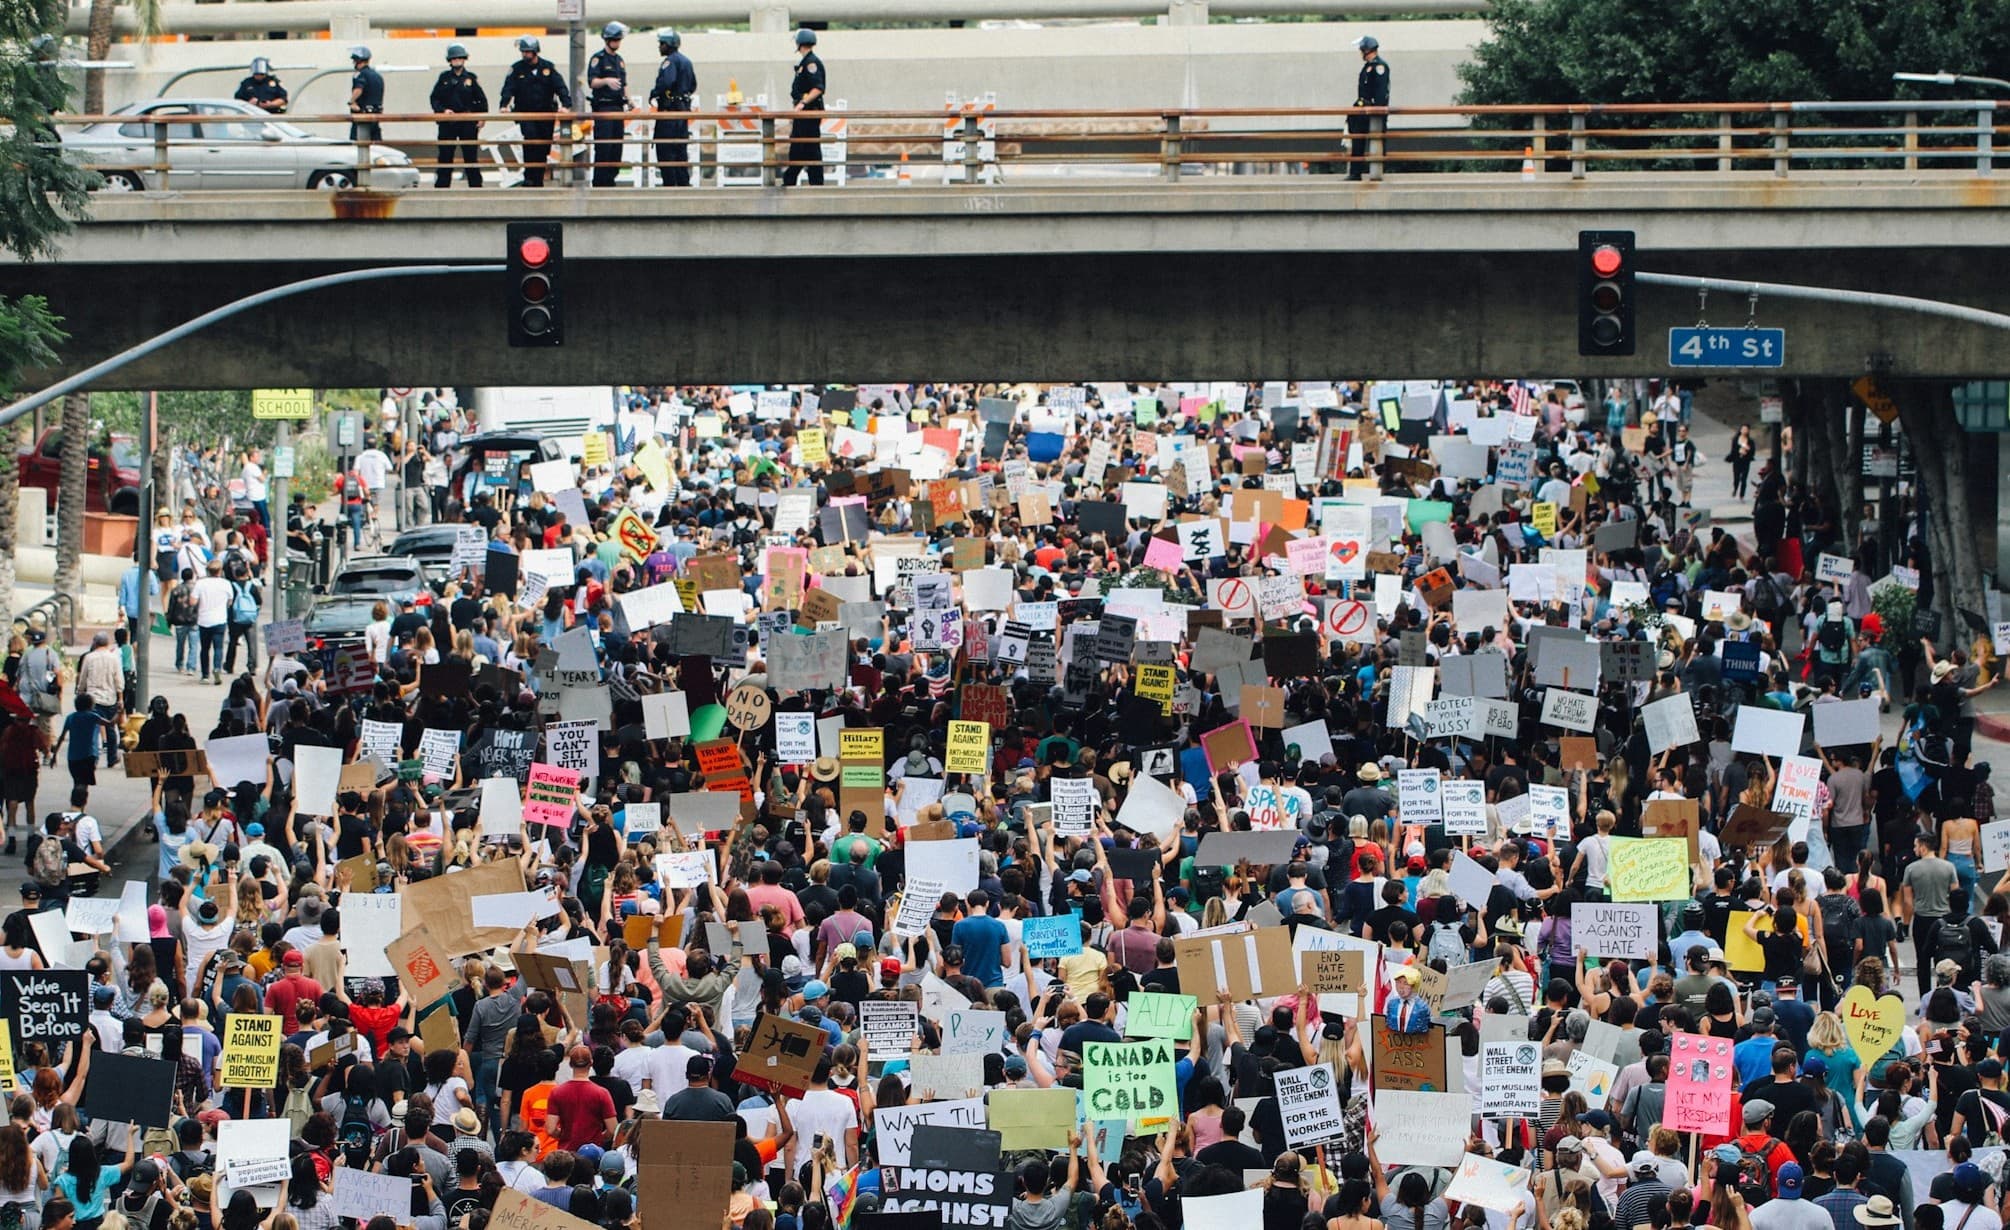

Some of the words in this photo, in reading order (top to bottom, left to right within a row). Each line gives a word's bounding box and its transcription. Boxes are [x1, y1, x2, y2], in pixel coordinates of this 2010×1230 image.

[1679, 335, 1730, 359] 4th
[1742, 338, 1773, 358] St
[258, 402, 309, 414] SCHOOL
[898, 557, 940, 575] OBSTRUCT
[1724, 658, 1756, 671] THINK
[545, 670, 555, 683] 4
[562, 670, 596, 684] YEARS
[1143, 667, 1169, 682] STAND
[1141, 679, 1170, 692] AGAINST
[736, 689, 764, 707] NO
[964, 686, 1003, 701] CIVIL
[1427, 697, 1473, 712] PROTECT
[1557, 696, 1570, 706] NO
[1569, 698, 1587, 710] HATE
[727, 704, 761, 729] DAPL
[1438, 709, 1462, 720] YOUR
[1552, 704, 1567, 715] NO
[1568, 707, 1588, 719] TRUMP
[546, 721, 569, 731] DEAR
[571, 719, 598, 729] TRUMP
[779, 726, 797, 734] FIGHT
[954, 724, 982, 735] STAND
[1430, 719, 1471, 734] PUSSY
[1497, 718, 1513, 731] BAD
[559, 730, 584, 740] YOU
[843, 734, 881, 744] Hillary
[952, 733, 983, 746] AGAINST
[553, 739, 591, 751] CAN'T
[701, 746, 731, 758] TRUMP
[480, 747, 511, 765] NEVER
[511, 748, 534, 762] MADE
[562, 750, 584, 761] SIT
[780, 749, 814, 757] WORKERS
[948, 748, 985, 760] ANTI-MUSLIM
[556, 759, 588, 769] WITH
[950, 757, 982, 768] BIGOTRY!
[1785, 761, 1818, 783] LOVE
[1401, 784, 1422, 793] FIGHT
[1402, 800, 1418, 808] FOR
[1445, 795, 1466, 803] FIGHT
[1531, 798, 1551, 807] FIGHT
[1402, 808, 1440, 817] WORKERS
[1447, 810, 1462, 818] FOR
[1463, 809, 1478, 817] THE
[1776, 800, 1808, 818] HATE
[1447, 817, 1485, 828] WORKERS
[1532, 812, 1548, 821] FOR
[1595, 909, 1642, 923] UNITED
[1030, 928, 1069, 941] SURVIVING
[1585, 924, 1644, 941] AGAINST
[1599, 938, 1638, 955] HATE
[1321, 952, 1342, 964] END
[1317, 963, 1346, 975] HATE
[1319, 974, 1345, 983] DUMP
[13, 975, 60, 997] We've
[1313, 983, 1349, 993] TRUMP
[19, 996, 60, 1014] Seen
[61, 991, 81, 1014] It
[1135, 995, 1197, 1028] ALLY
[1850, 1002, 1881, 1021] LOVE
[20, 1013, 81, 1039] Before
[235, 1018, 273, 1033] STAND
[866, 1021, 912, 1030] NEGAMOS
[1863, 1020, 1893, 1039] trumps
[232, 1032, 275, 1048] AGAINST
[1860, 1030, 1883, 1047] hate
[226, 1052, 277, 1066] ANTI-MUSLIM
[1086, 1045, 1171, 1069] CANADA
[1486, 1047, 1508, 1058] WALL
[1391, 1051, 1425, 1069] ASS
[1485, 1055, 1514, 1069] STREET
[229, 1064, 268, 1079] BIGOTRY!
[1108, 1069, 1122, 1083] is
[1125, 1069, 1148, 1081] too
[1485, 1065, 1492, 1075] IS
[1493, 1065, 1505, 1075] THE
[1278, 1076, 1305, 1089] WALL
[1384, 1075, 1400, 1085] BAD
[1280, 1083, 1314, 1101] STREET
[1484, 1084, 1501, 1092] NOT
[1502, 1083, 1538, 1092] MUSLIMS
[1091, 1086, 1165, 1112] COLD
[1282, 1097, 1291, 1106] IS
[1291, 1093, 1304, 1104] THE
[1303, 1088, 1333, 1102] ENEMY.
[1503, 1091, 1517, 1100] OR
[1676, 1091, 1695, 1105] NOT
[1702, 1092, 1723, 1106] MY
[1484, 1099, 1539, 1110] IMMIGRANTS
[1287, 1114, 1308, 1125] FOR
[1310, 1108, 1329, 1118] THE
[1289, 1118, 1341, 1138] WORKERS
[339, 1171, 394, 1193] ANGRY
[900, 1168, 996, 1196] MOMS
